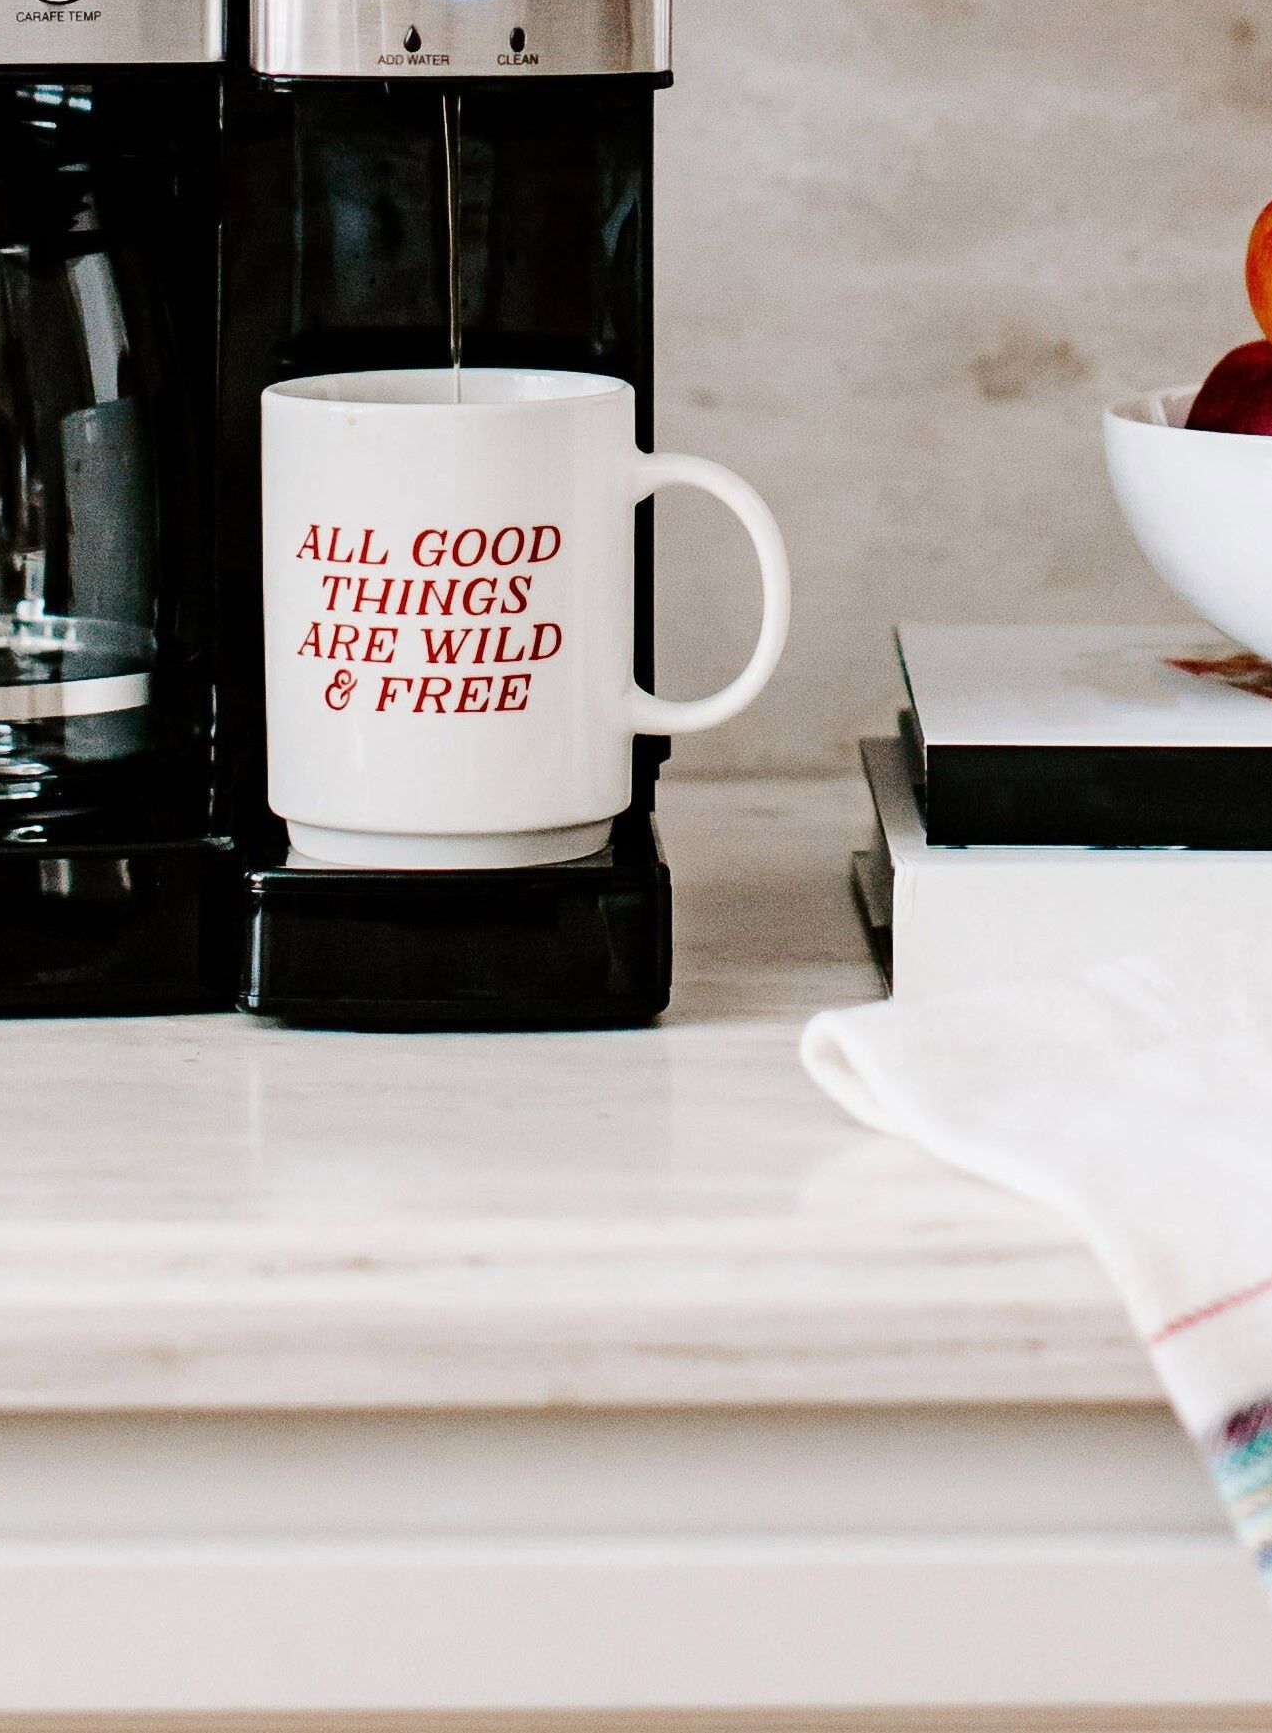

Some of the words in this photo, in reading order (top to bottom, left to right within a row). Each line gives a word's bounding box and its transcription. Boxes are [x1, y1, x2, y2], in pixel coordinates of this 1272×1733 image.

[15, 11, 64, 23] CARAFE
[68, 11, 102, 22] TEMP
[377, 54, 405, 66] ADD
[407, 54, 450, 66] WATER
[497, 54, 539, 66] CLEAN
[295, 524, 390, 566] ALL
[411, 524, 562, 568] GOOD
[322, 574, 533, 616] THINGS
[297, 621, 399, 664] ARE
[420, 622, 563, 665] WILD
[325, 668, 358, 711] &
[375, 673, 533, 714] FREE
